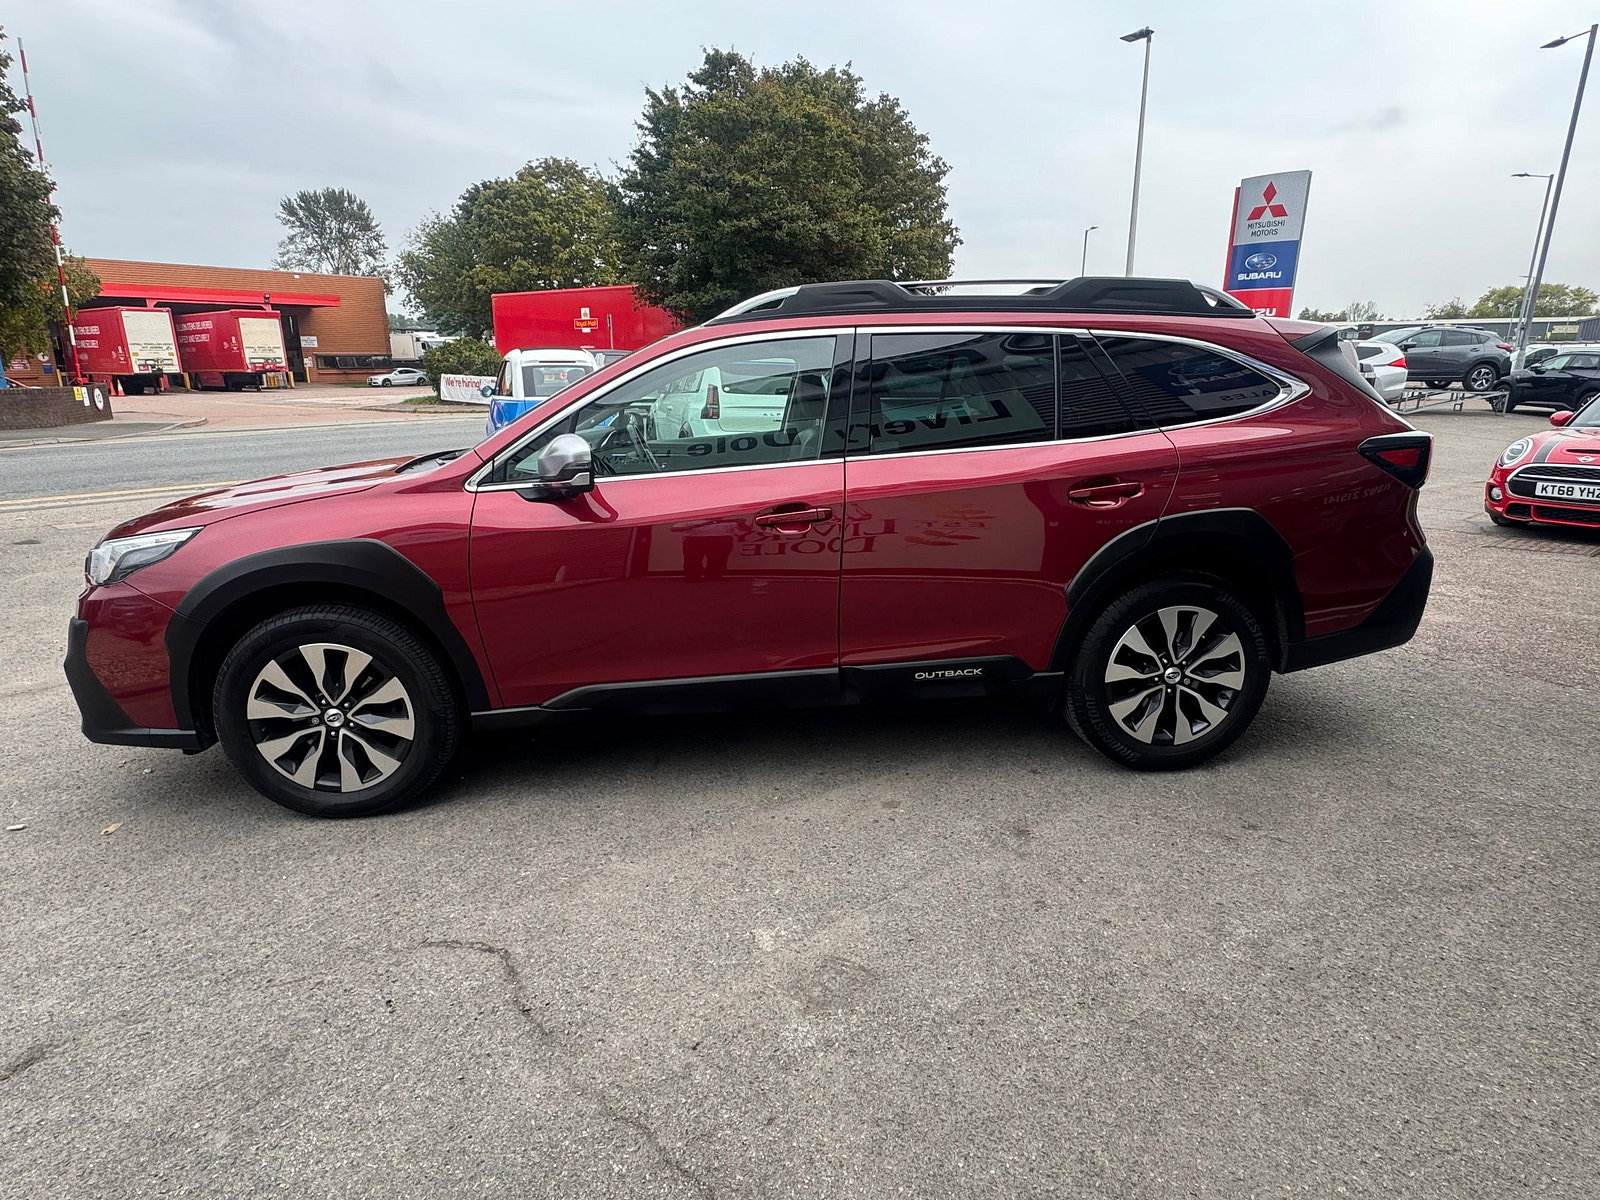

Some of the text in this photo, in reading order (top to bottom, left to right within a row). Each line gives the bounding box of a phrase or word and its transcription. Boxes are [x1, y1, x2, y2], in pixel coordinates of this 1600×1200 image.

[1247, 220, 1286, 230] MITSUBISHI
[1251, 228, 1279, 238] MOTORS
[1237, 271, 1282, 281] SUBARU
[1251, 307, 1277, 317] ZU
[445, 376, 482, 391] We're hiring!
[1540, 484, 1575, 496] KT68
[1216, 590, 1269, 663] BRIDGESTONE
[914, 668, 983, 680] OUTBACK
[1085, 692, 1143, 763] BRIDGESTONE
